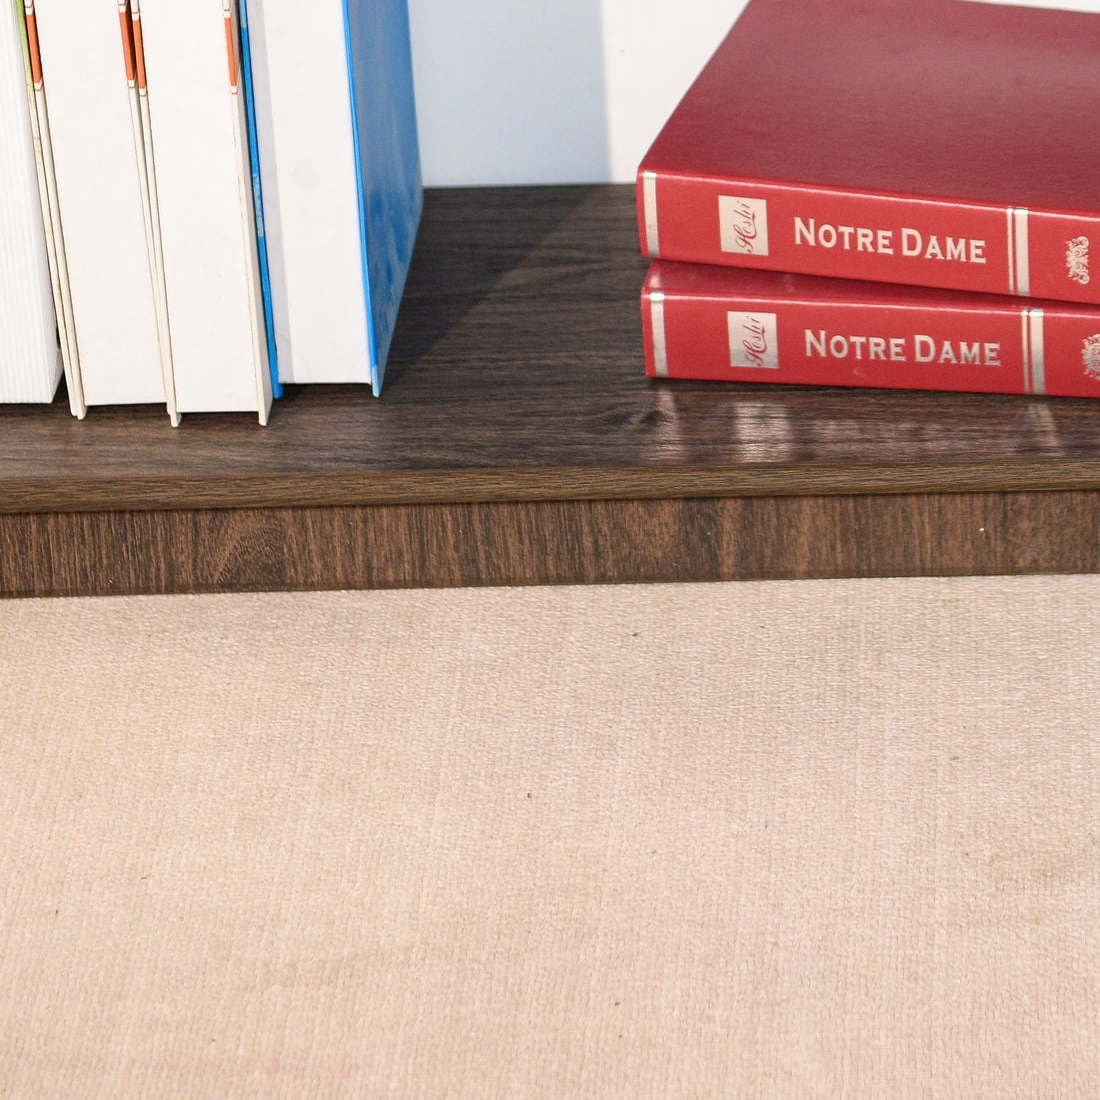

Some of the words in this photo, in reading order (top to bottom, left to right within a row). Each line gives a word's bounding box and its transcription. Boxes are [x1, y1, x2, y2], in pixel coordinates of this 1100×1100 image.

[794, 217, 894, 255] NOTRE
[902, 227, 987, 264] DAME
[805, 329, 906, 361] NOTRE
[914, 335, 1001, 366] DAME
